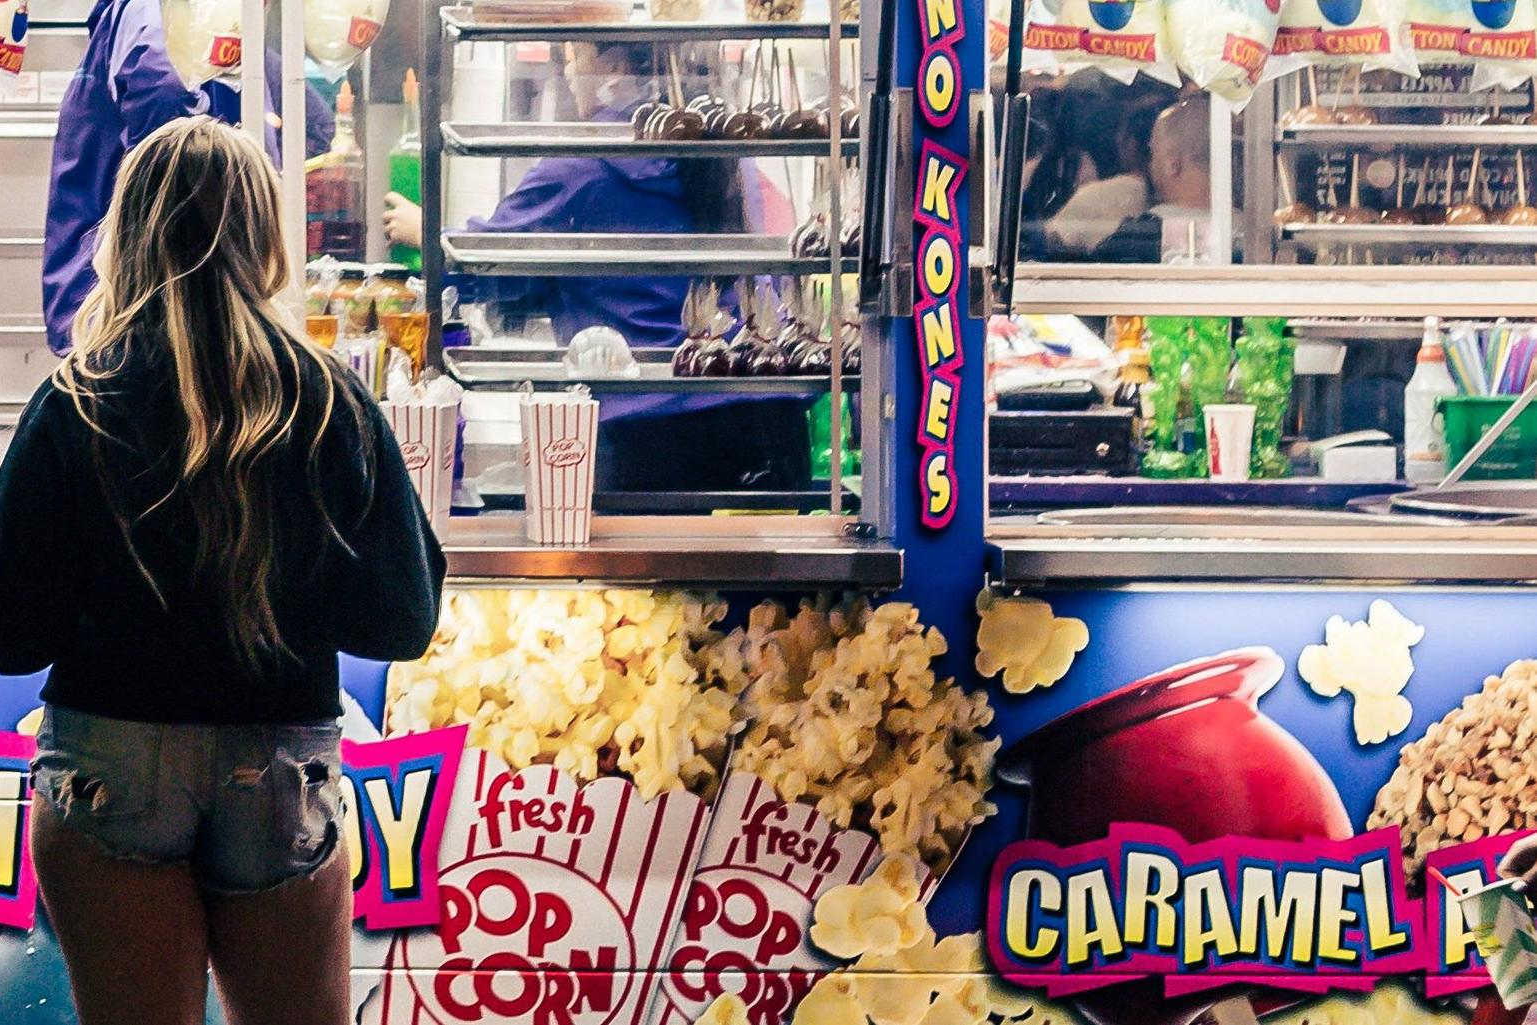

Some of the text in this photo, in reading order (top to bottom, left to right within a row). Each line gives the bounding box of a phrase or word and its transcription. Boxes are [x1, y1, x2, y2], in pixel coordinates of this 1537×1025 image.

[1090, 36, 1150, 59] CANDY
[1325, 31, 1383, 53] CANDY
[1411, 29, 1531, 57] TTON CANDY
[922, 155, 954, 514] KONES
[479, 772, 595, 849] fresh
[742, 800, 841, 874] fresh
[436, 869, 573, 960] POP
[682, 878, 801, 966] POP
[1006, 851, 1408, 966] CARAMEL
[434, 946, 618, 1025] CORN
